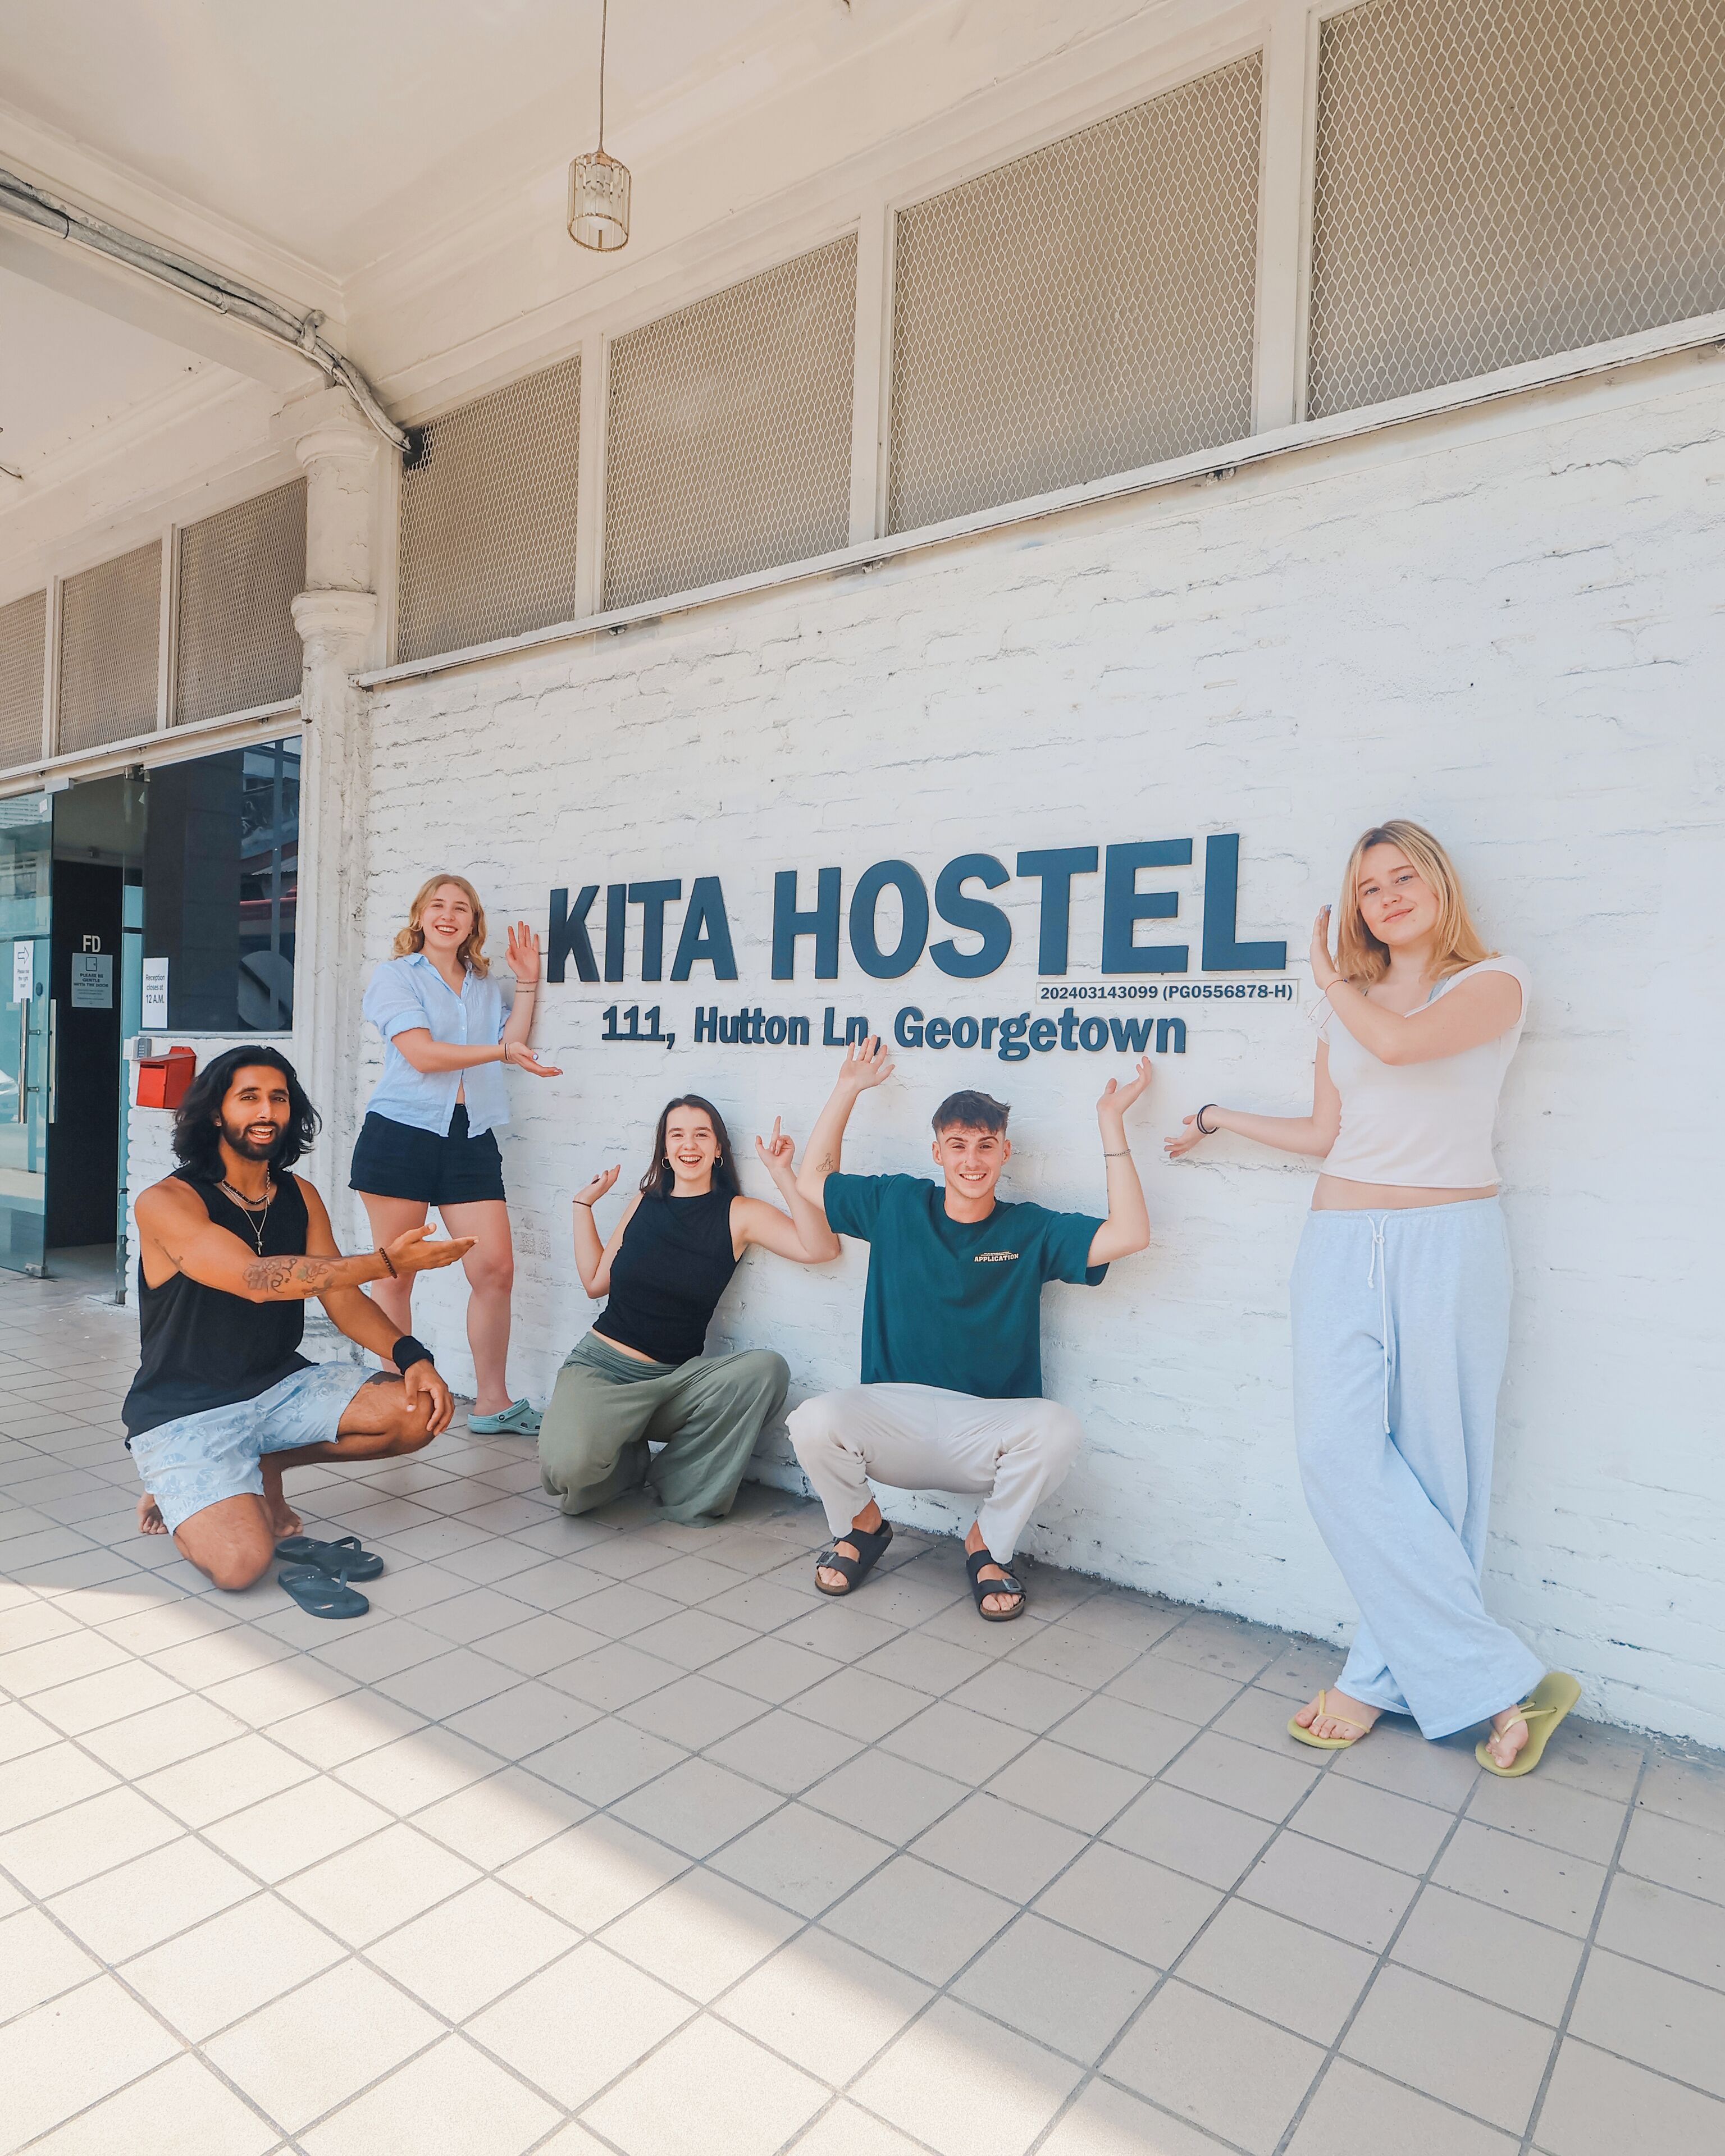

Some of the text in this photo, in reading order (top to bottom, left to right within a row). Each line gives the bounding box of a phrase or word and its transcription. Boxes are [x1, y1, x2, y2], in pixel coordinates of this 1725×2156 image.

[547, 833, 1286, 983] KITA HOSTEL
[83, 934, 101, 953] FD
[146, 995, 152, 1003] 12
[1041, 984, 1292, 1001] 202403143099 (PG0556878-H)
[602, 1006, 675, 1049] 111,
[694, 1006, 809, 1045] Hutton
[895, 1006, 1186, 1061] Georgetown
[974, 1253, 1019, 1262] APPLICATION
